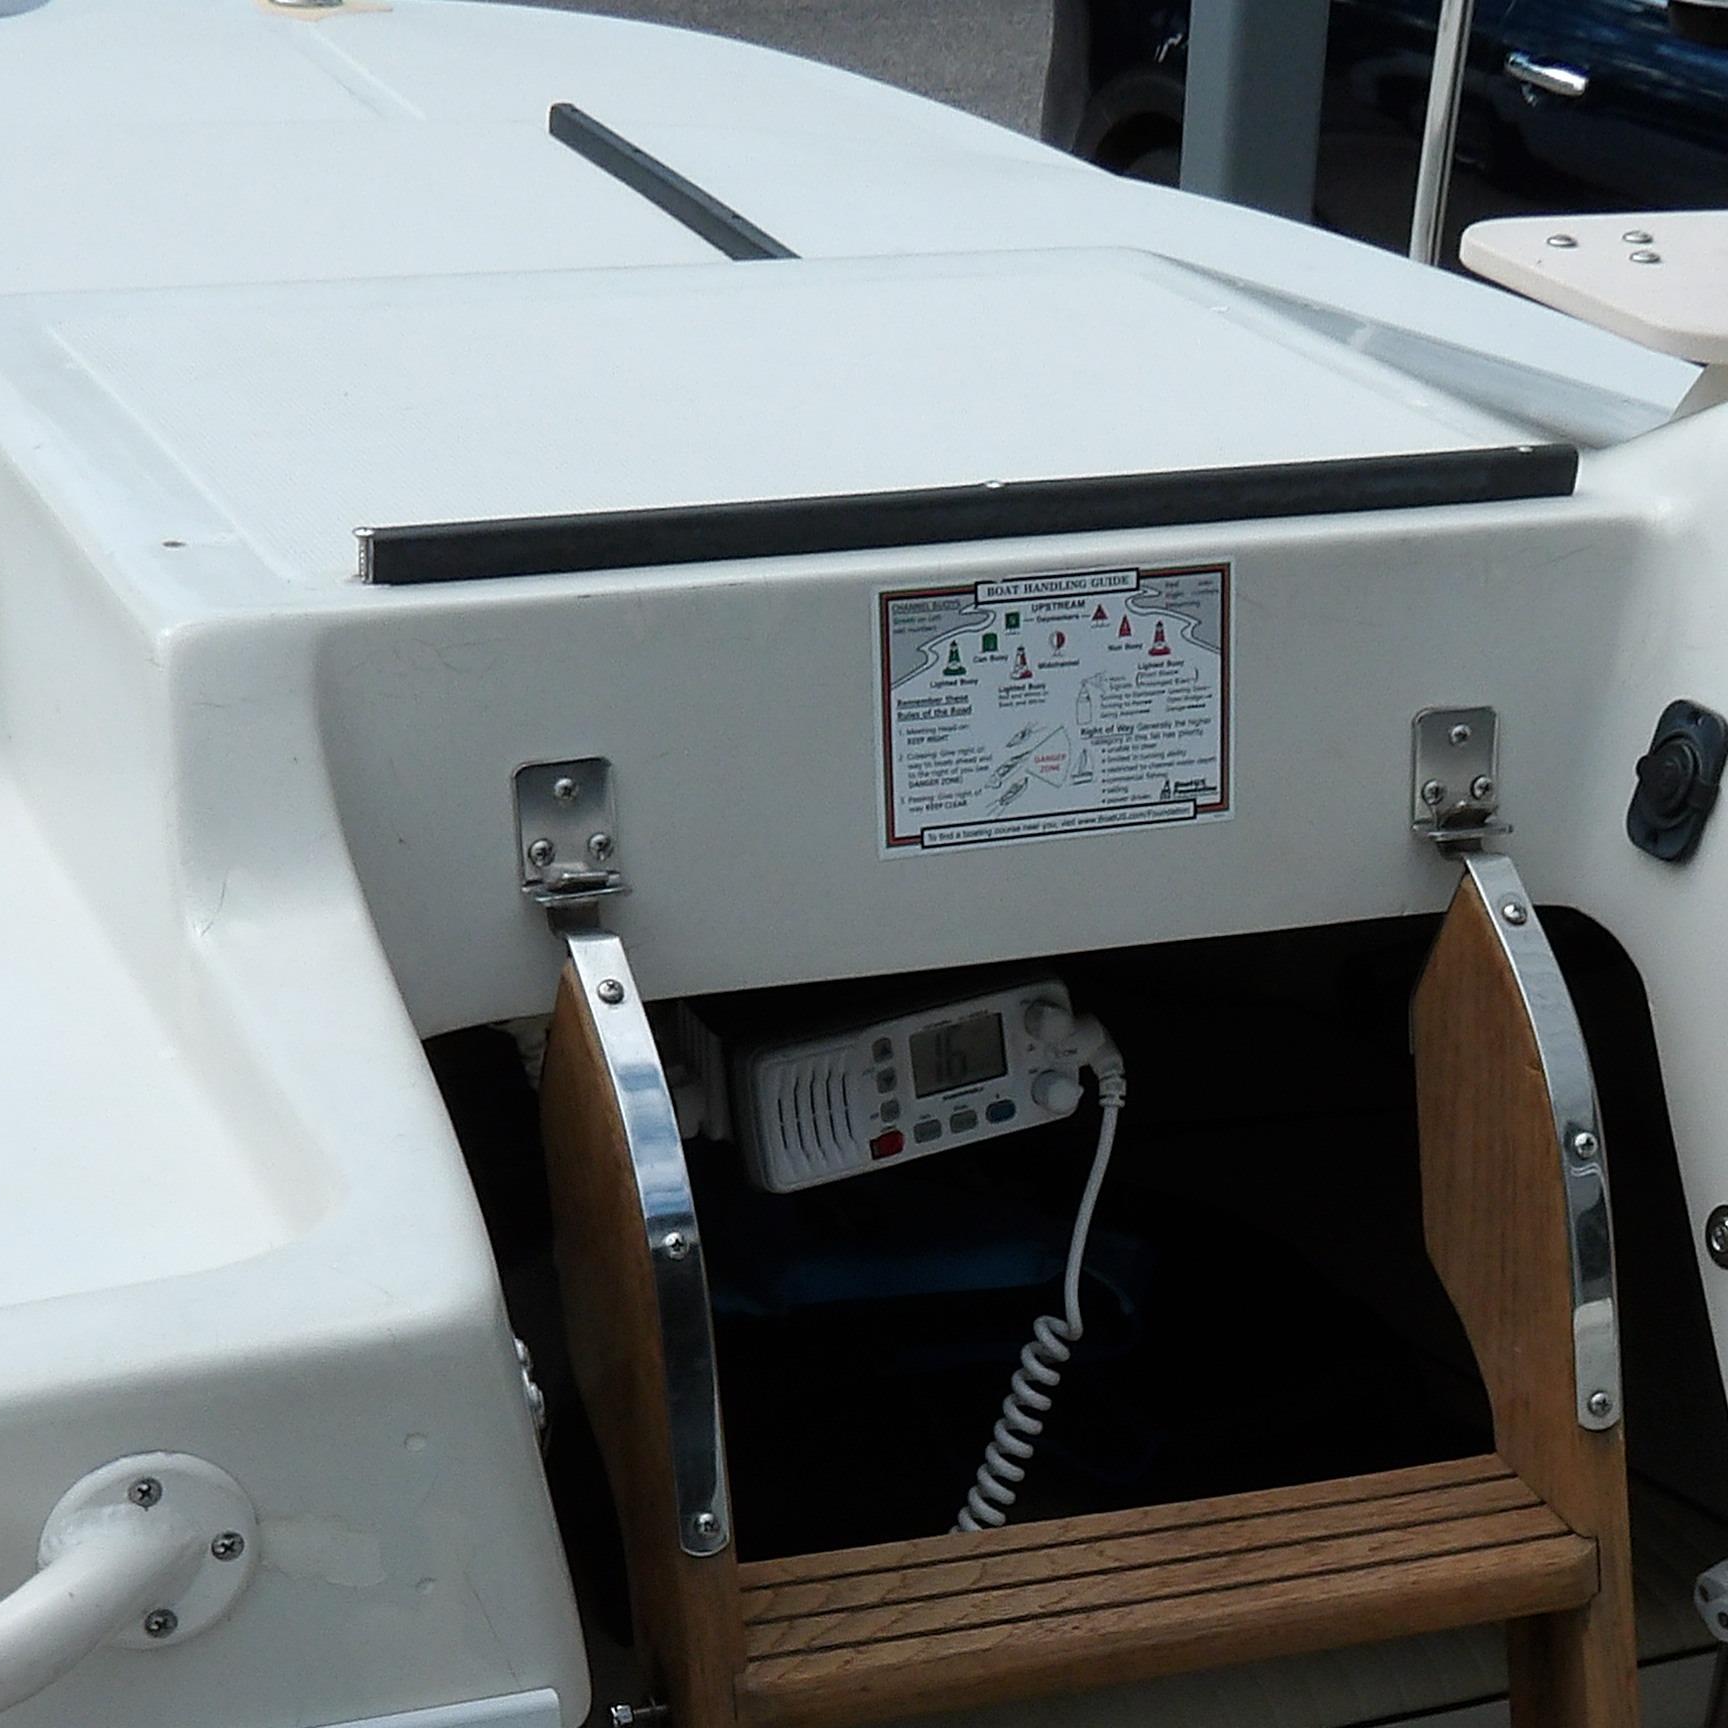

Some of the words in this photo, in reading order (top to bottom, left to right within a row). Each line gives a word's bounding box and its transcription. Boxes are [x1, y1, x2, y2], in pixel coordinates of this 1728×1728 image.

[987, 585, 1019, 598] BOAT
[1024, 579, 1087, 594] HANDLING
[1091, 575, 1132, 589] GUIDE
[1031, 599, 1085, 612] UPSTREAM
[1081, 726, 1103, 738] Right
[1104, 724, 1115, 733] of
[1034, 752, 1067, 764] DANGER
[1040, 764, 1061, 773] ZONE
